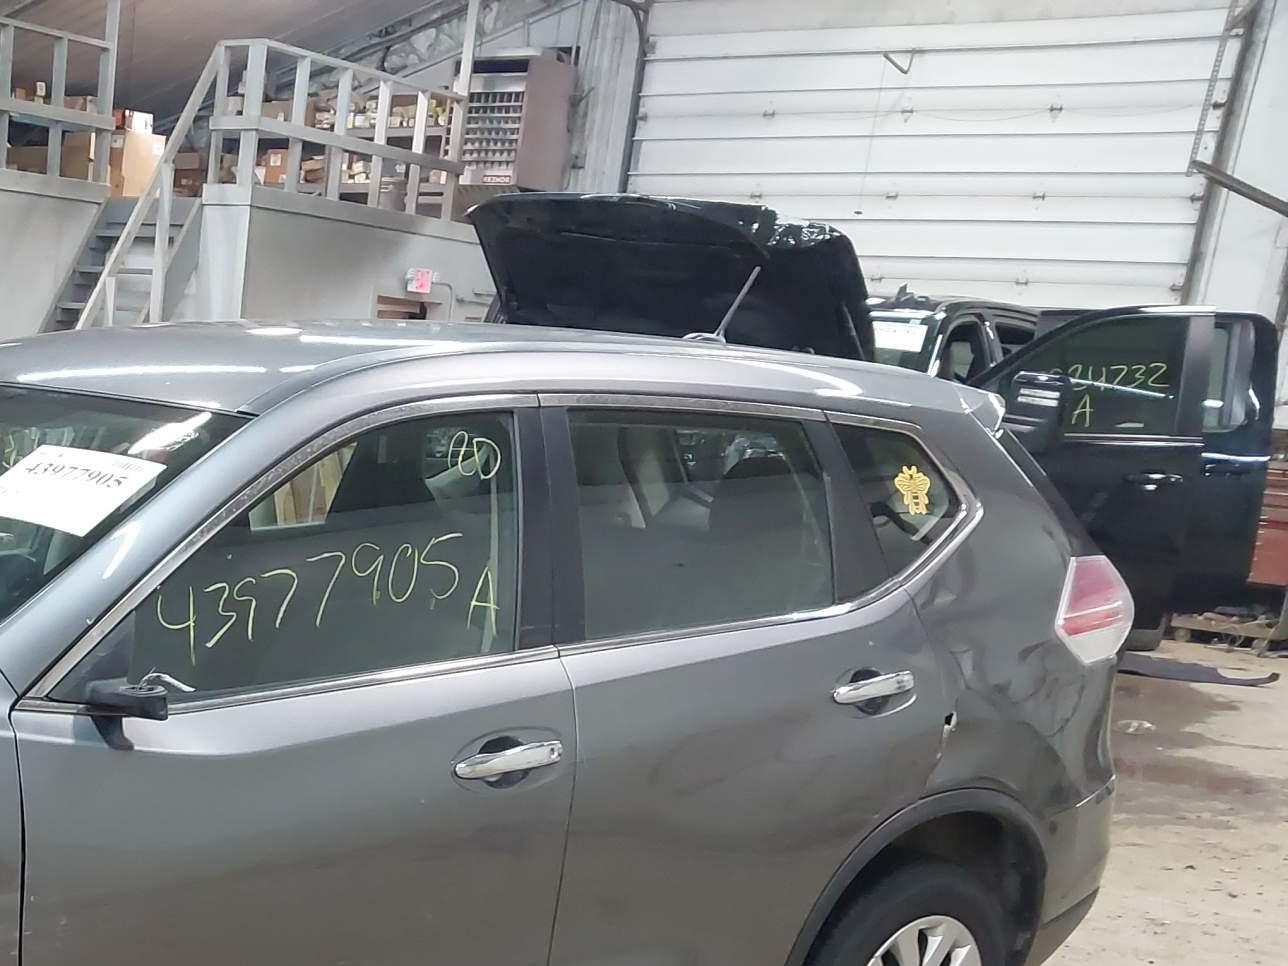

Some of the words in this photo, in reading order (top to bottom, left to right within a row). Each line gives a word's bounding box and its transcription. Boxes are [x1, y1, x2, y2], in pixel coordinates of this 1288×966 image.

[1071, 394, 1095, 427] A
[25, 462, 129, 489] 43977905
[157, 533, 463, 665] 43977905
[467, 566, 500, 637] A
